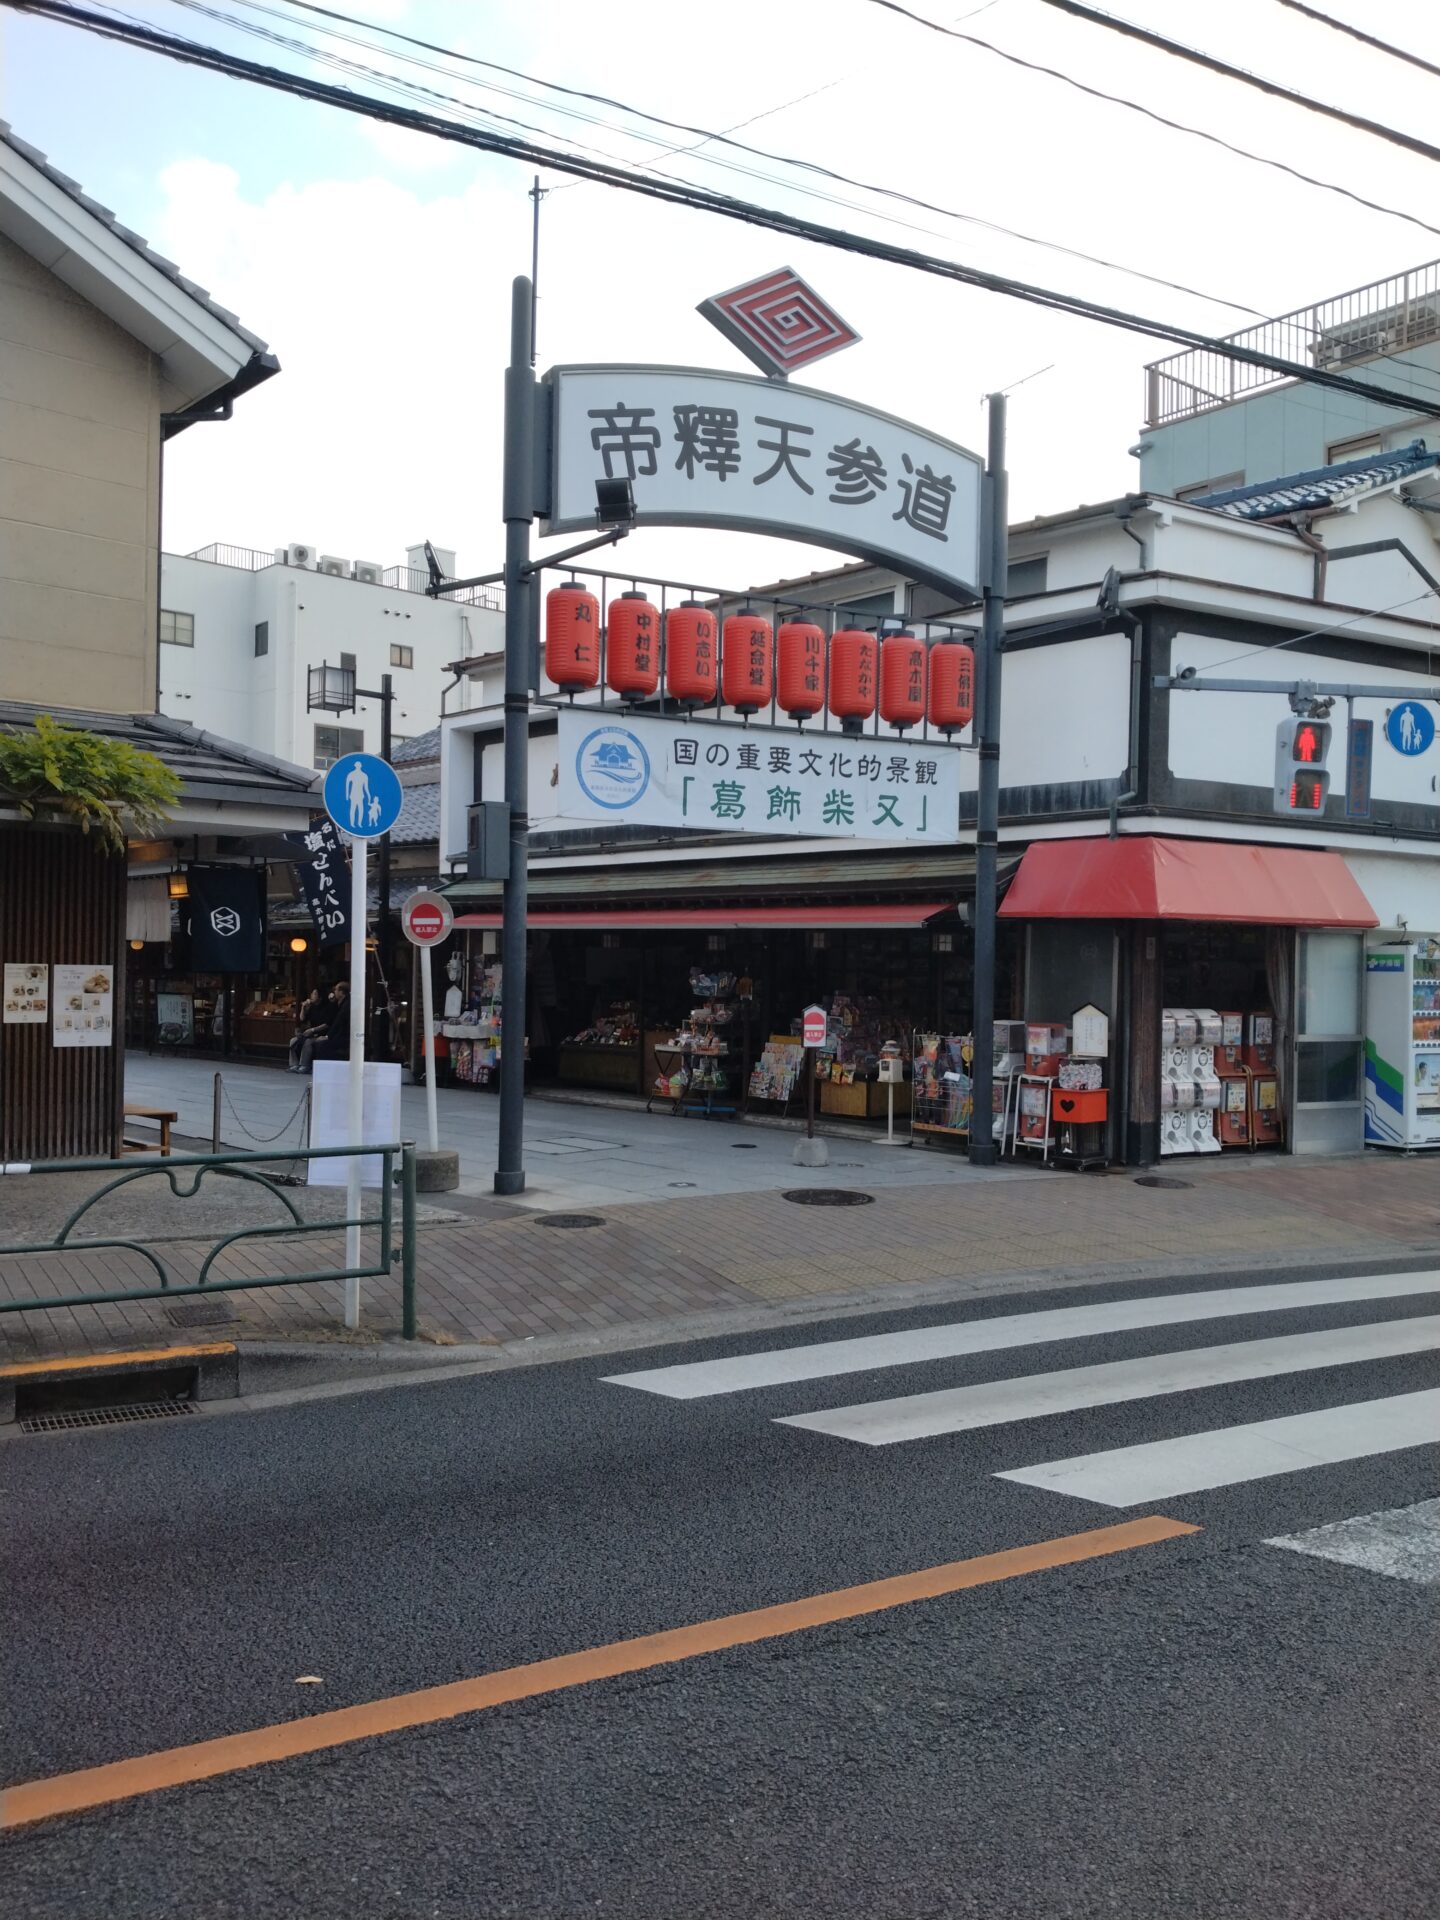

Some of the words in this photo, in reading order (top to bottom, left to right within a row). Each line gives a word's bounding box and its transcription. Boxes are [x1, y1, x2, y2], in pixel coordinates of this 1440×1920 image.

[587, 402, 957, 543] 帝釋天参道
[574, 602, 592, 662] 丸仁
[634, 612, 651, 672] 中村堂
[748, 630, 765, 686] 延命堂
[673, 738, 938, 785] 国の重要文化的景観
[681, 775, 927, 832] 「葛飾柴又」
